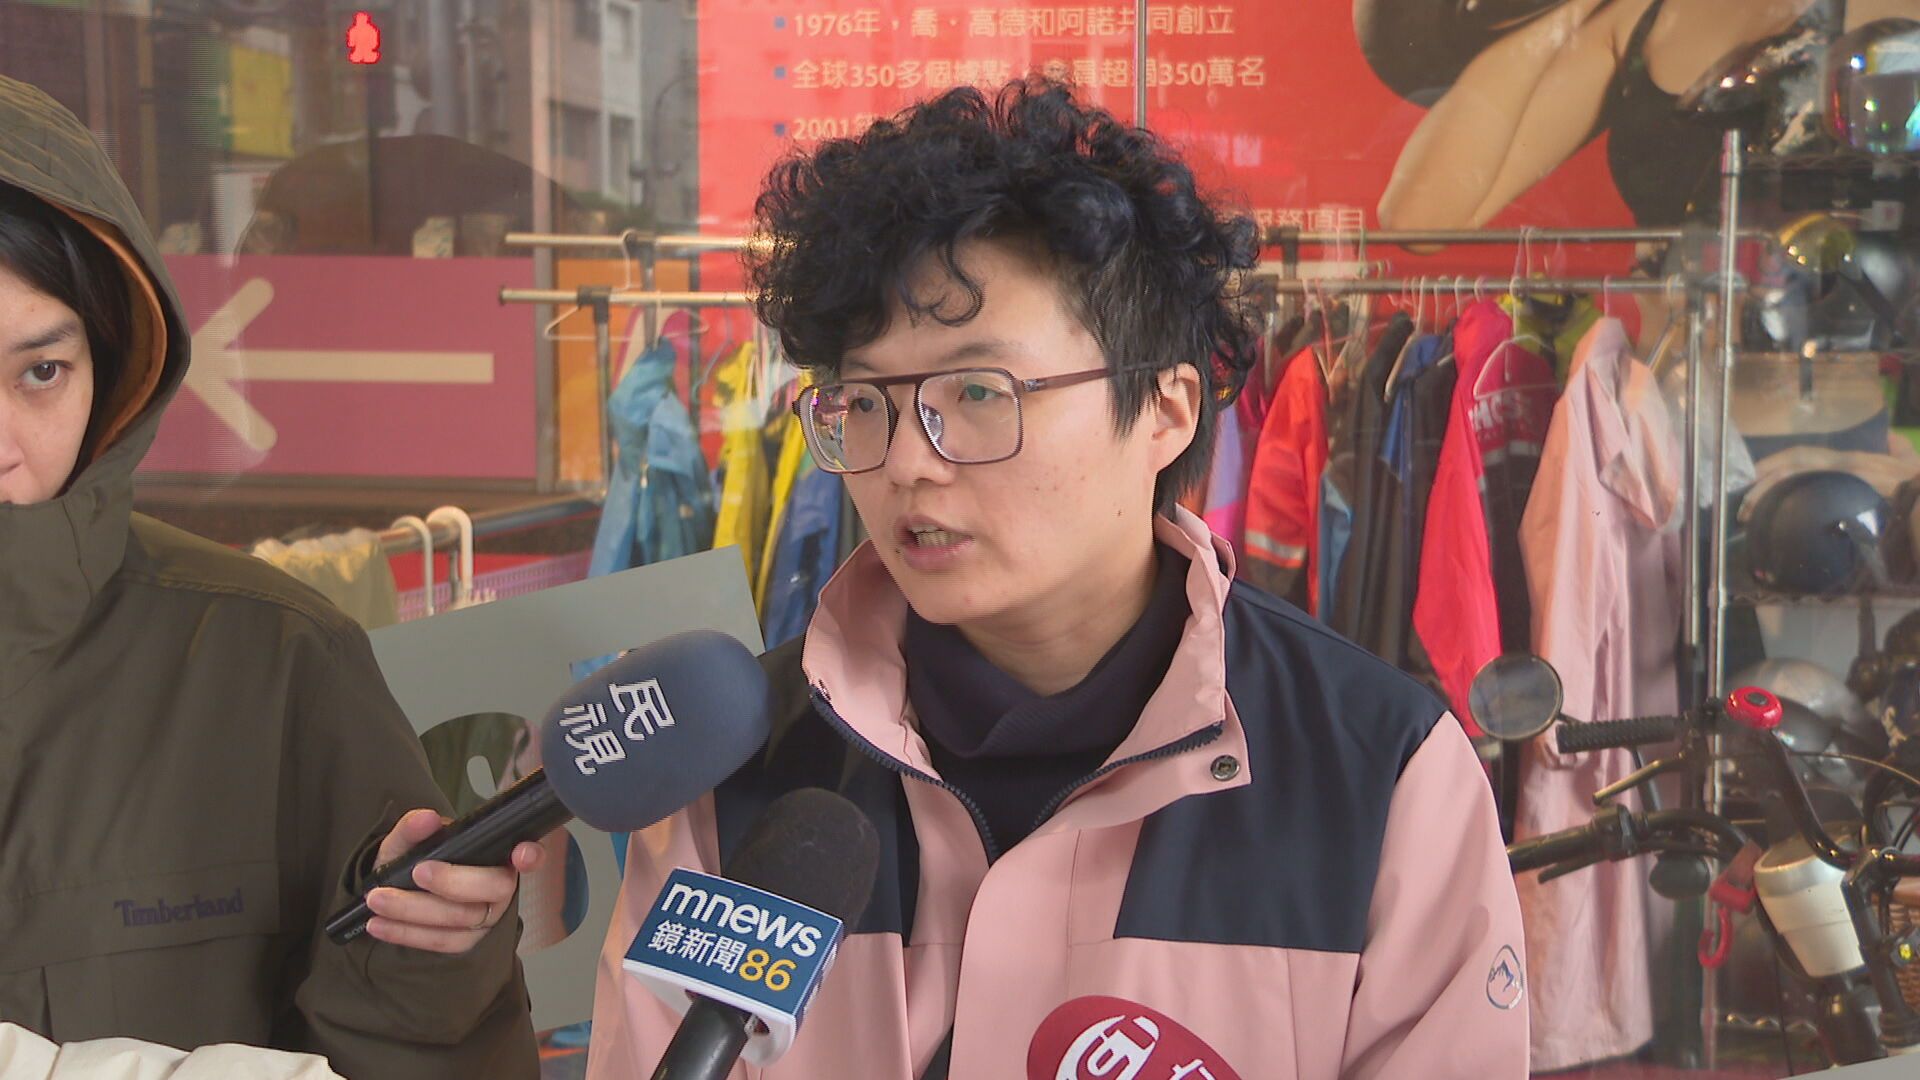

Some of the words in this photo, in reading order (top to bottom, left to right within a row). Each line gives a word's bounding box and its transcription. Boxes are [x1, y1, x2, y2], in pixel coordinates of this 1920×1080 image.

[558, 677, 677, 776] 民視
[112, 886, 243, 928] Timberland
[660, 882, 823, 958] mnews
